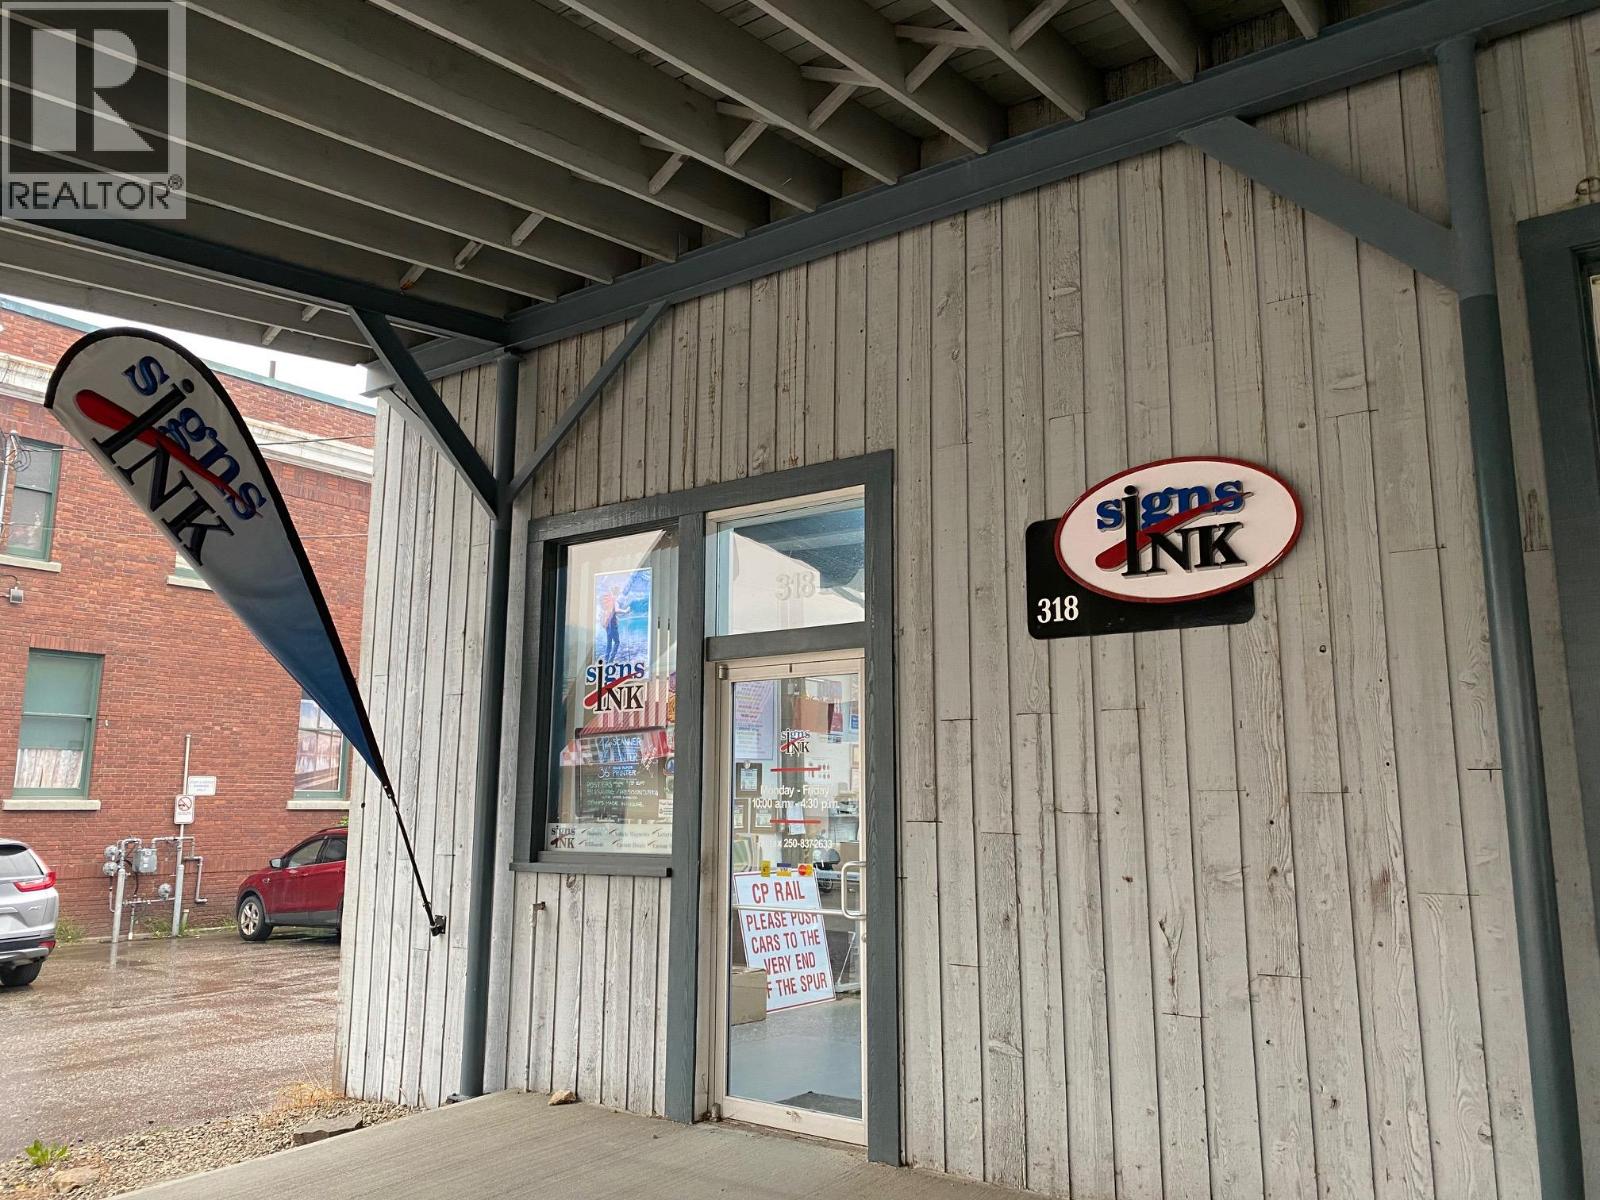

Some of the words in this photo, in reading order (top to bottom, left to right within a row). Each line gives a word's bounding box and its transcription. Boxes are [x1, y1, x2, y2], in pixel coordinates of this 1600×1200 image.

[120, 355, 267, 521] signs
[1095, 480, 1245, 532] signs
[1121, 513, 1248, 578] INK
[775, 571, 816, 601] 318
[1036, 595, 1080, 624] 318
[585, 659, 646, 684] signs
[594, 678, 644, 712] INK
[781, 728, 811, 740] signs
[752, 798, 773, 809] 10:00
[800, 798, 819, 809] 4:30
[752, 883, 769, 904] CP
[774, 881, 805, 902] RAIL
[746, 911, 788, 932] PLEASE
[790, 911, 819, 927] PUSH
[751, 933, 781, 954] CARS
[783, 931, 798, 949] TO
[800, 929, 821, 947] THE
[763, 954, 792, 976] VERY
[795, 951, 816, 971] END
[775, 977, 798, 998] THE
[799, 972, 828, 993] SPUR
